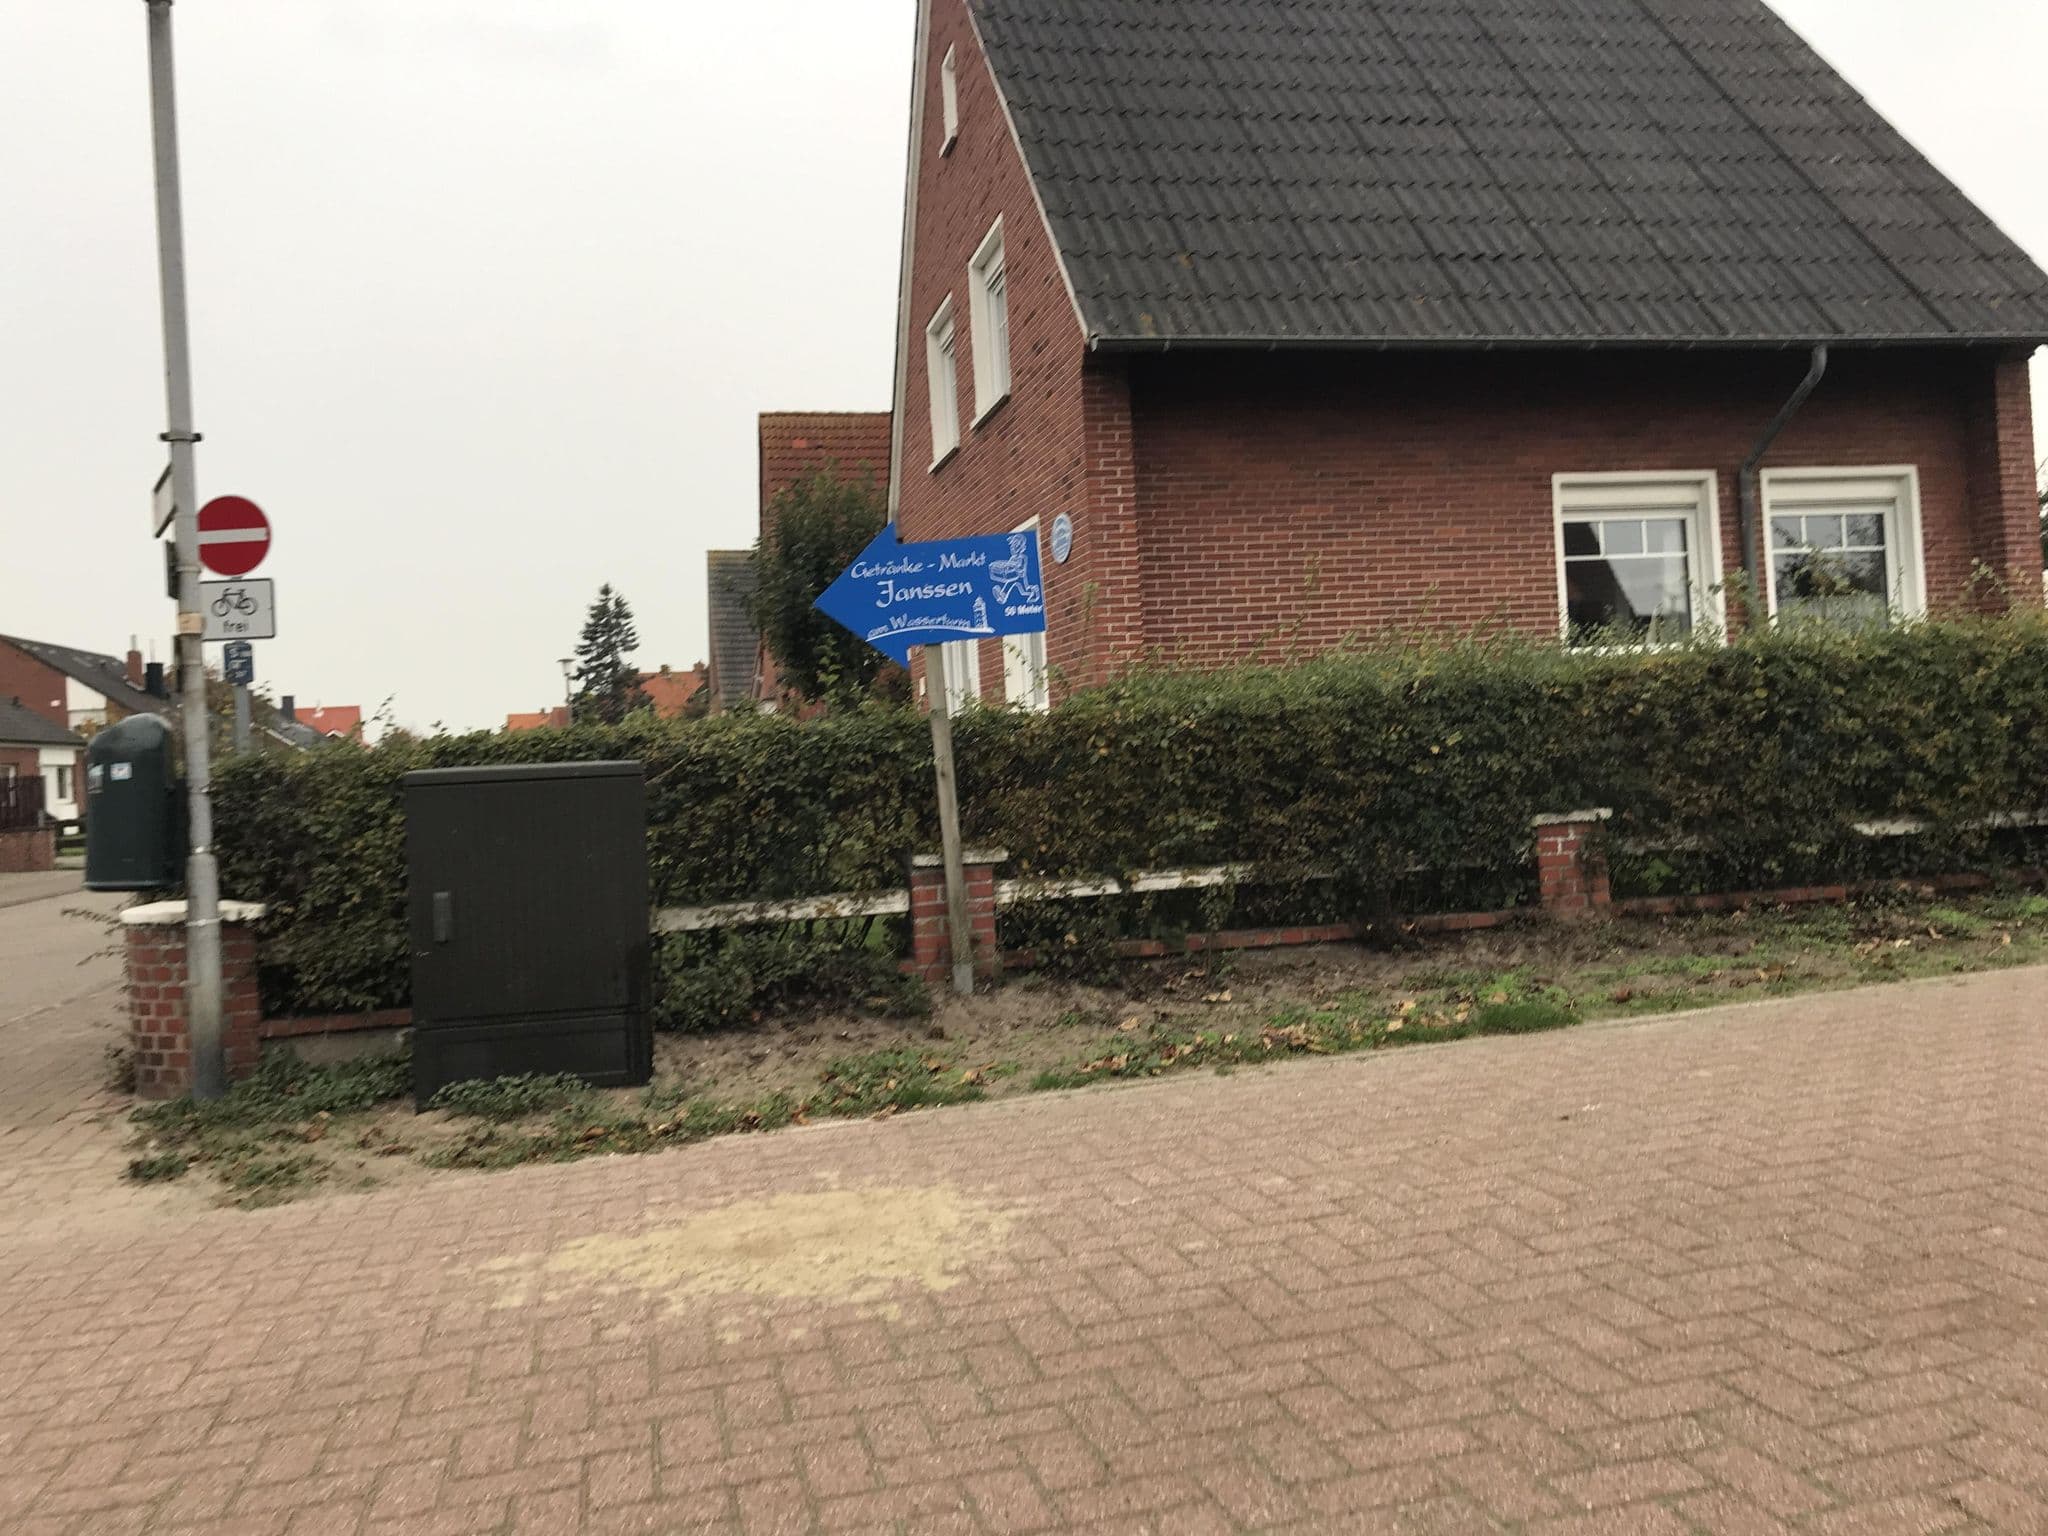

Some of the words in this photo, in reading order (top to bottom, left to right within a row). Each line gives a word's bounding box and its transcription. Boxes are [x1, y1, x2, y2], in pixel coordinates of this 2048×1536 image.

[851, 556, 924, 579] Getränke
[938, 550, 986, 572] Markt
[875, 580, 973, 608] Janssen
[223, 619, 249, 633] frei
[889, 613, 971, 630] Wasserturm
